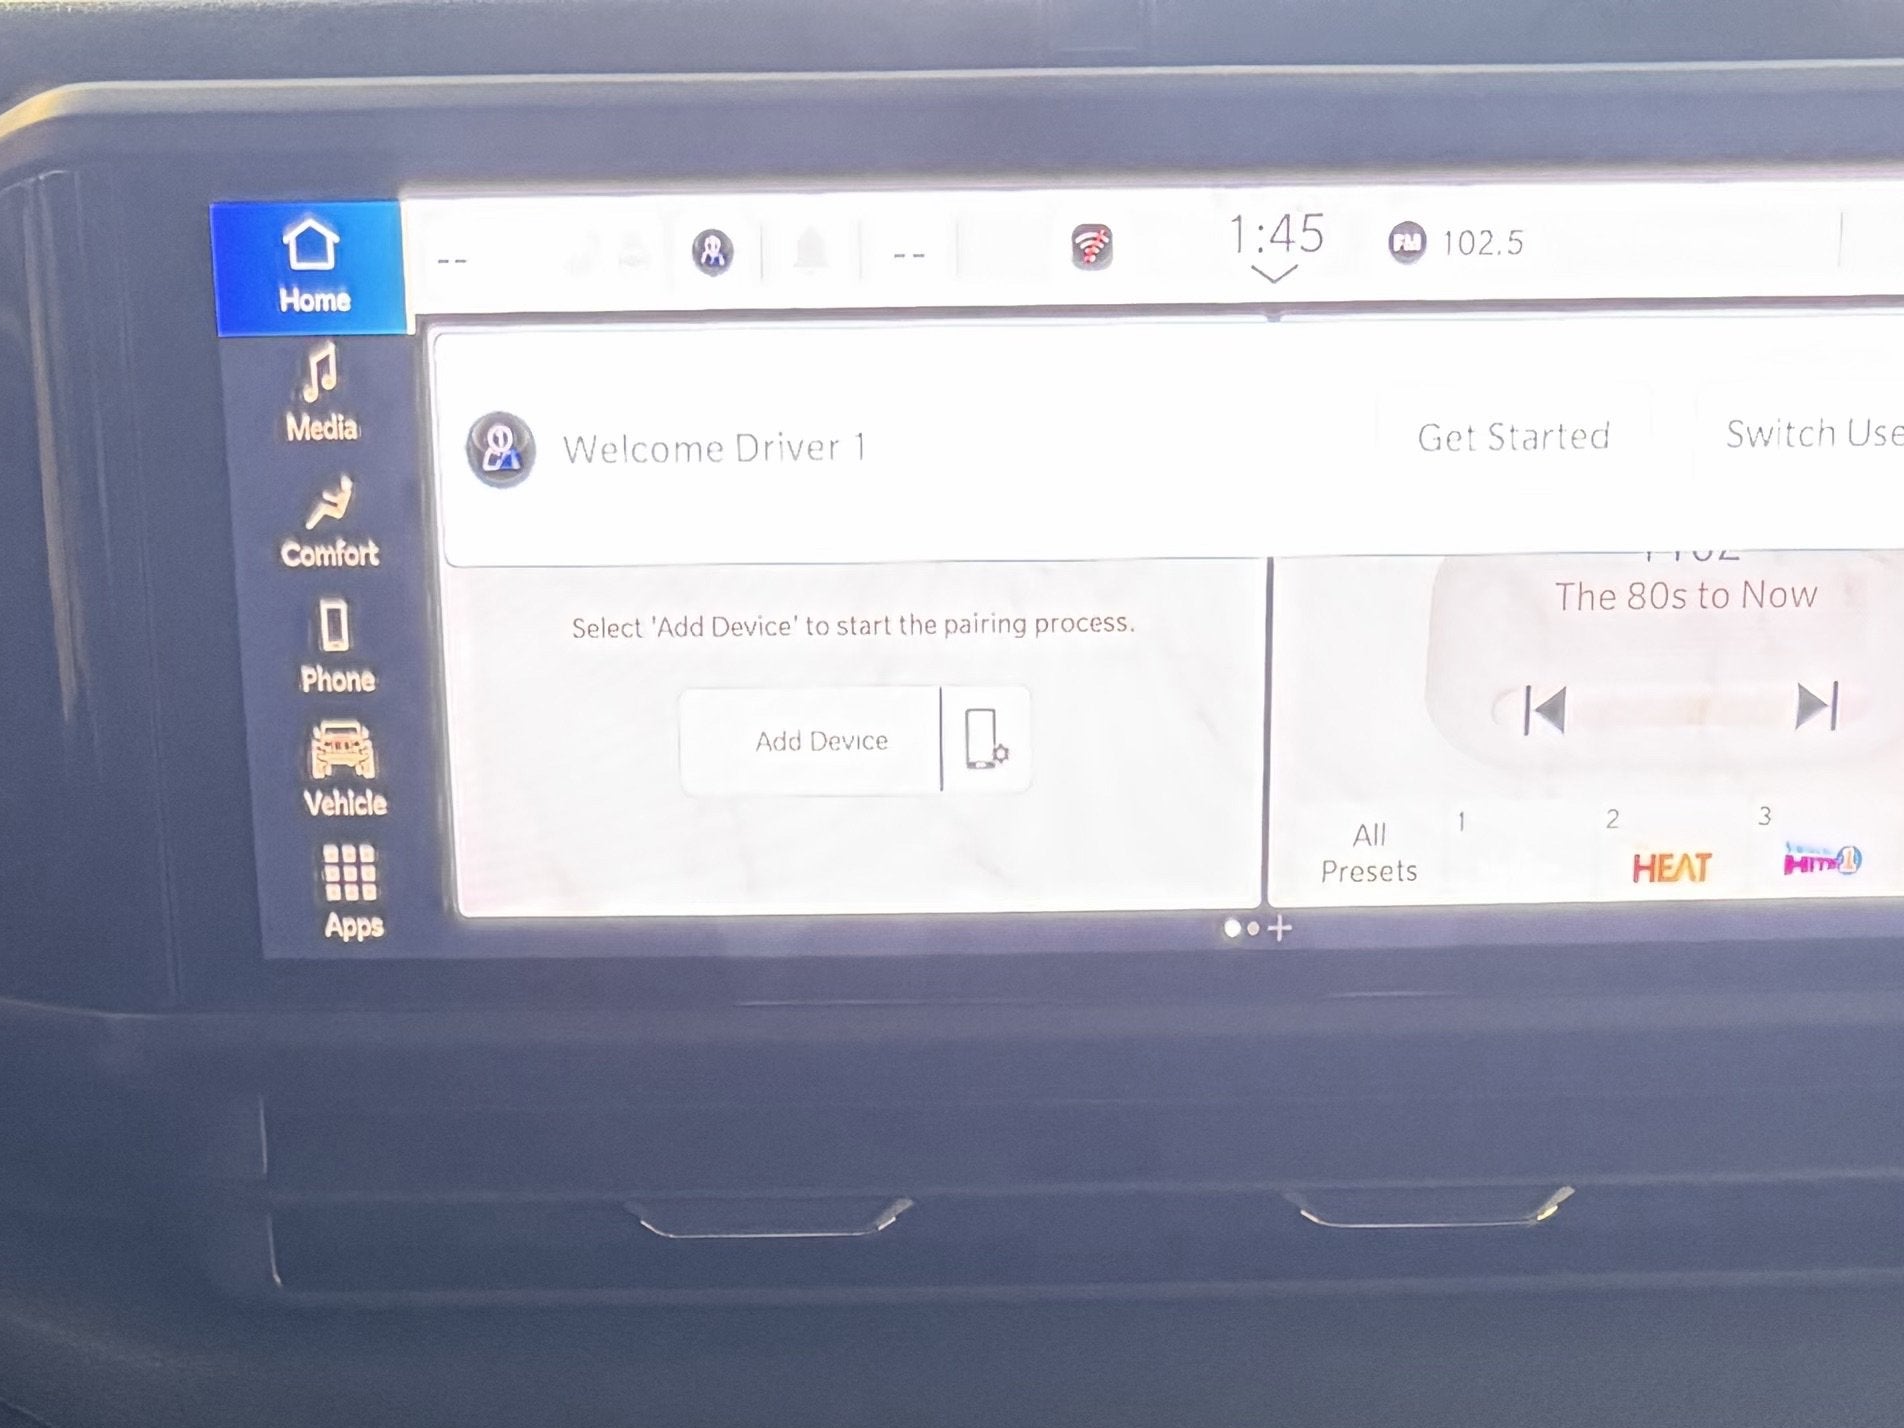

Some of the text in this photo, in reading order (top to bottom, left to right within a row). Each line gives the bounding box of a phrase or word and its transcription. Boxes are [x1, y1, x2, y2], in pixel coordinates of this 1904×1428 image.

[1230, 212, 1325, 254] 1:45
[1445, 229, 1525, 256] 102.5
[279, 288, 352, 313] Home
[286, 414, 358, 442] Media
[1418, 419, 1610, 453] Get Started
[1725, 417, 1836, 449] Switch
[563, 431, 865, 464] Welcome Driver 1
[281, 540, 381, 568] Comfort
[1556, 579, 1818, 611] The 80s to Now
[572, 616, 643, 639] Select
[806, 614, 831, 636] to
[836, 614, 893, 637] start
[899, 611, 937, 636] the
[945, 612, 1026, 644] pairing
[1035, 614, 1135, 642] process.
[300, 665, 377, 693] Phone
[755, 729, 887, 752] Add Device
[304, 790, 388, 818] Vehicle
[1758, 806, 1772, 827] 3
[1457, 812, 1466, 832] 1
[1606, 809, 1620, 830] 2
[1352, 822, 1387, 849] All
[1321, 857, 1418, 886] Presets
[1633, 851, 1712, 884] HEAT
[324, 912, 385, 943] Apps
